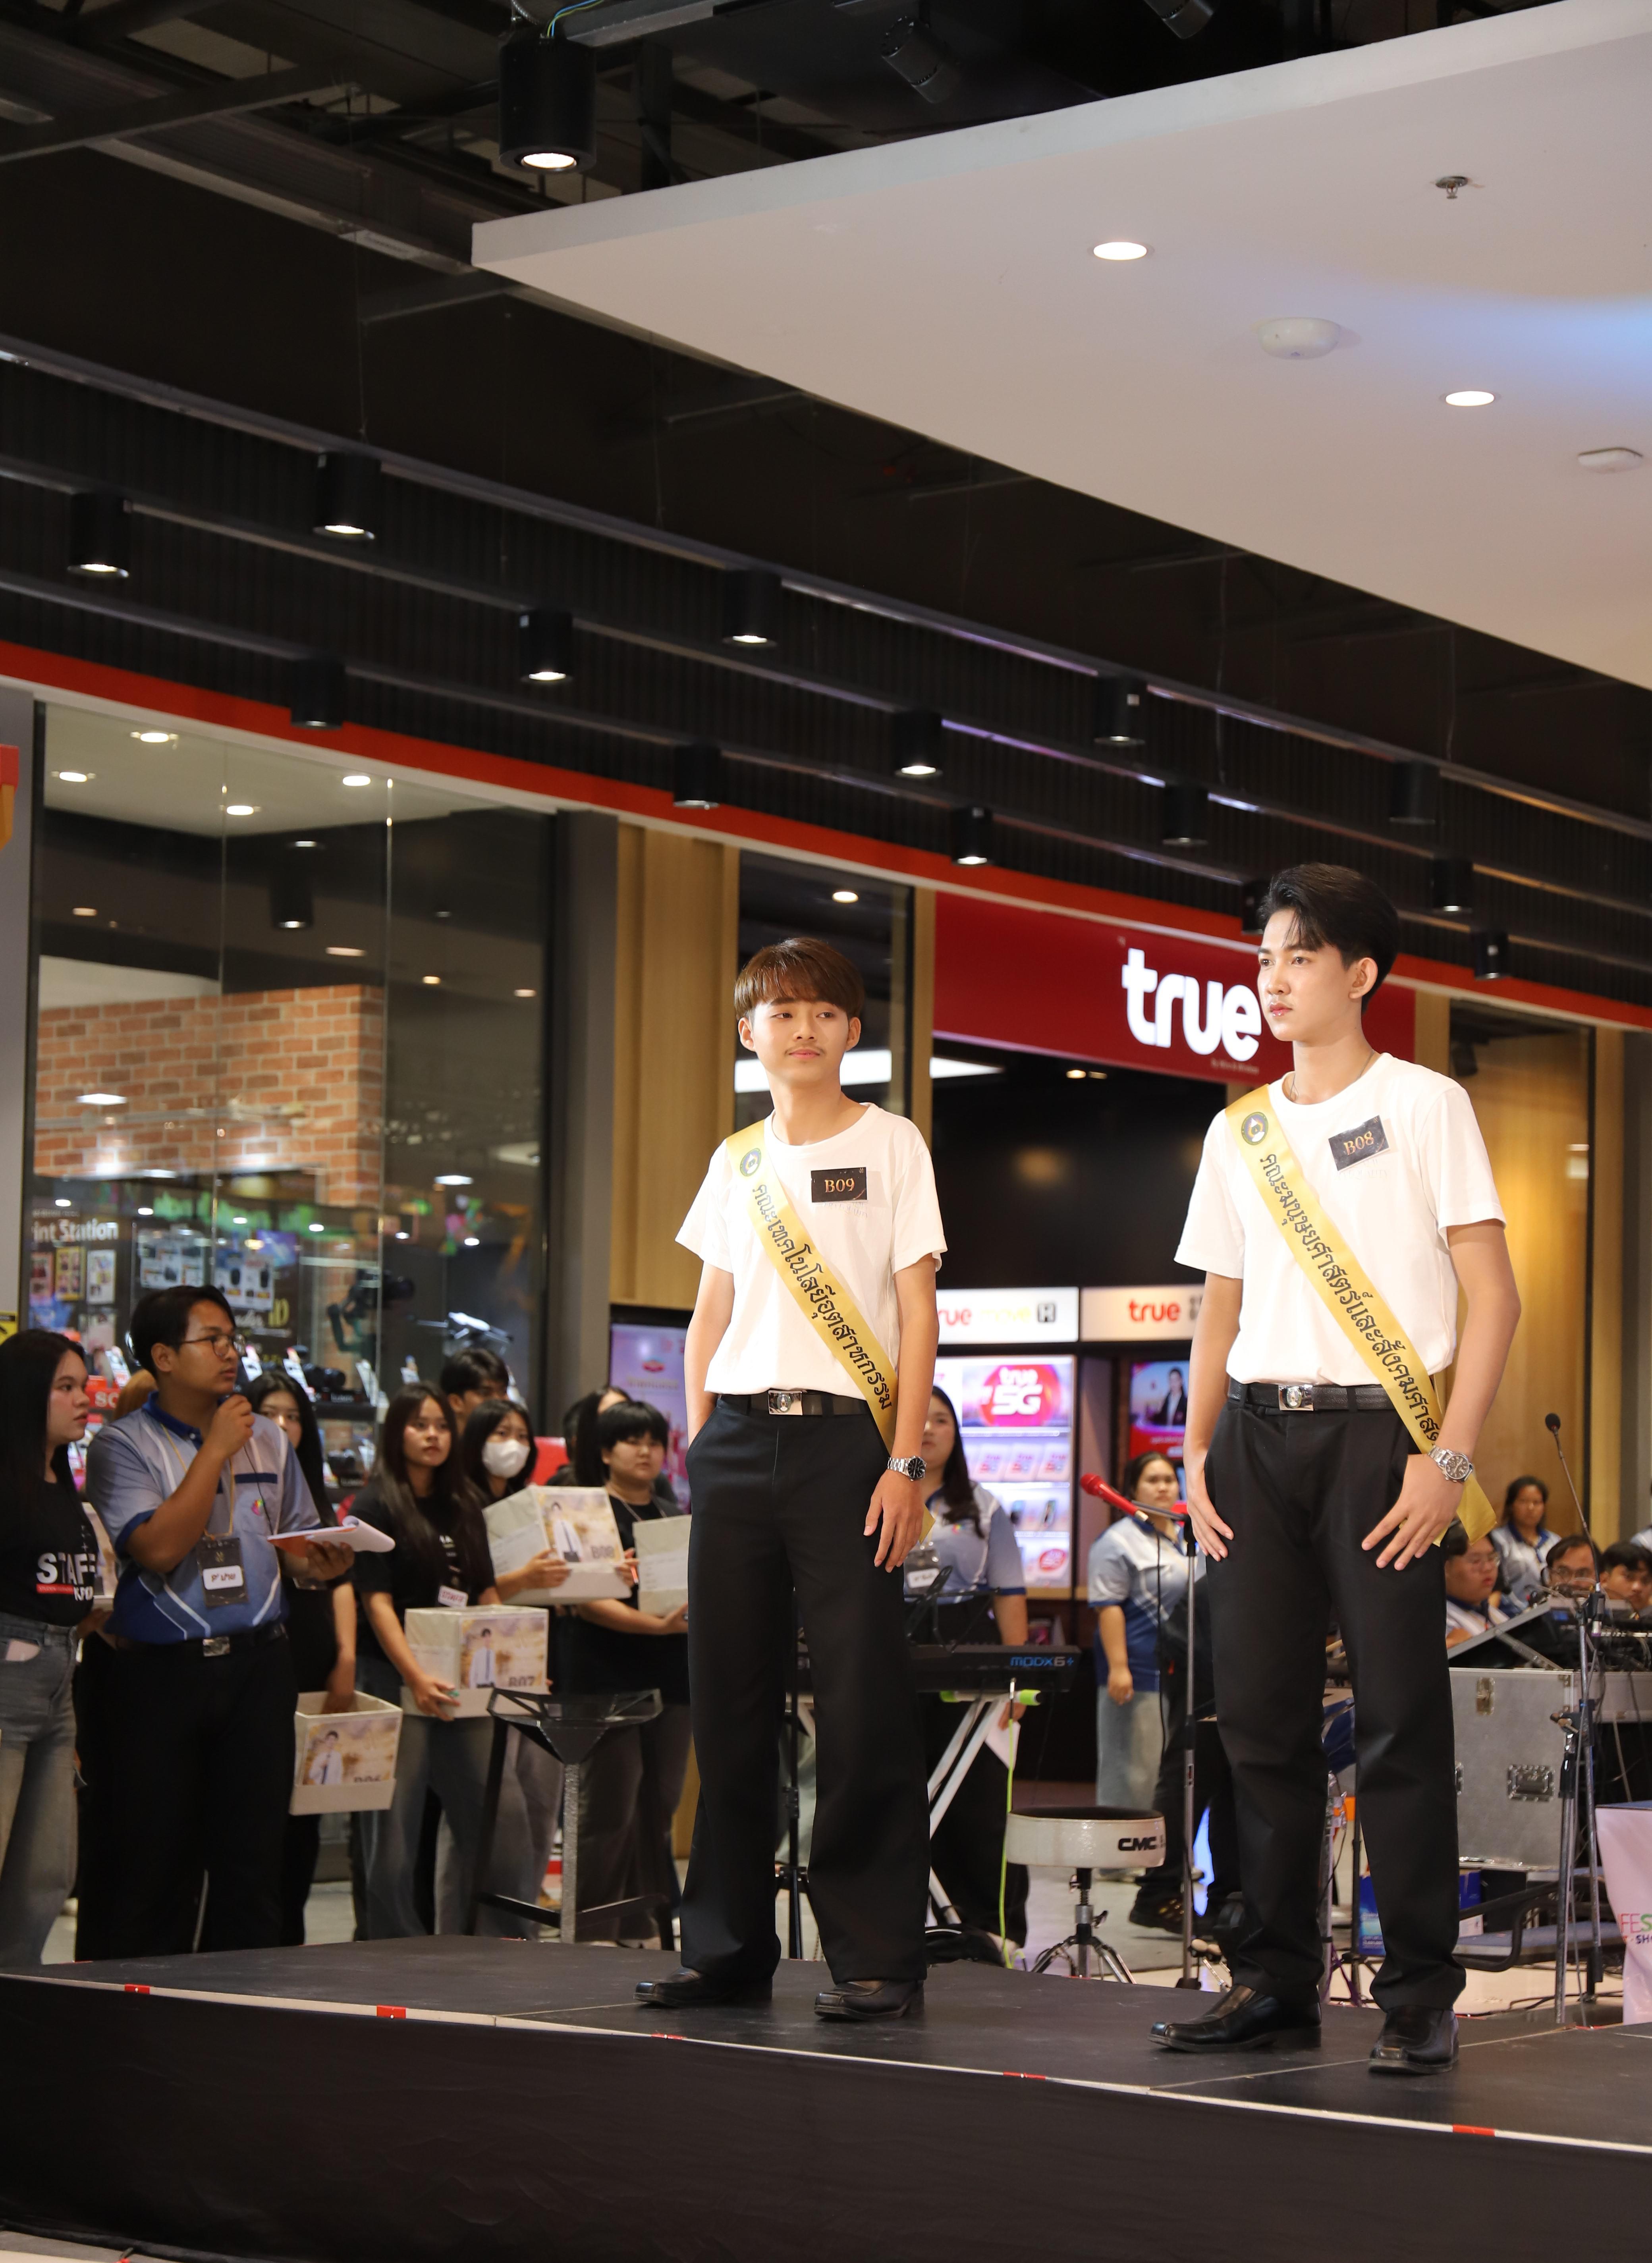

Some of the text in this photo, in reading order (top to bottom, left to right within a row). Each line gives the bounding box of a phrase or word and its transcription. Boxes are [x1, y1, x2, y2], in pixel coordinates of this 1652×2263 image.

[1121, 947, 1262, 1062] true
[1343, 1131, 1374, 1155] B08
[825, 1178, 855, 1193] B09
[31, 1217, 118, 1244] int Station
[752, 1184, 892, 1410] คณะเทคโนโลยีอุตสาหกรรม
[938, 1308, 972, 1325] rue
[1129, 1298, 1181, 1323] true
[991, 1384, 1043, 1415] 5G
[1118, 1836, 1157, 1851] CMC
